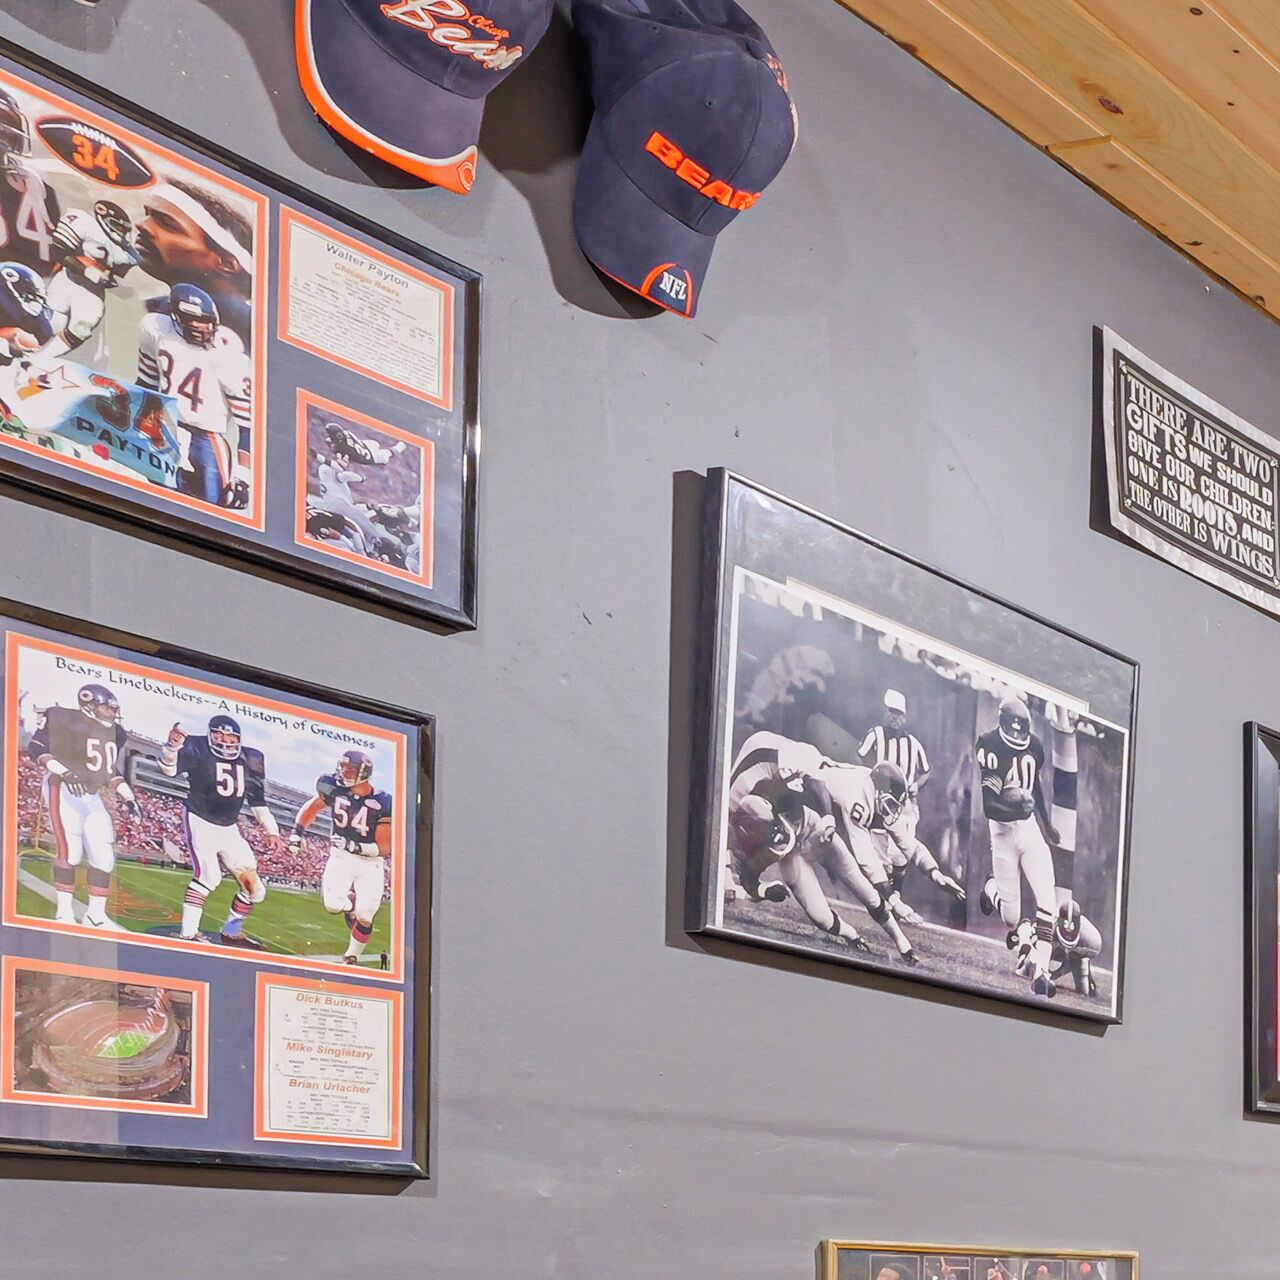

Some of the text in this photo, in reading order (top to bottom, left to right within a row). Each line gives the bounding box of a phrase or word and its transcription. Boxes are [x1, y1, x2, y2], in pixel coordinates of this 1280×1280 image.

[72, 134, 119, 181] 34
[325, 243, 409, 289] Walter Payton
[334, 262, 372, 284] Chicago
[659, 271, 688, 301] NFL
[75, 416, 177, 478] PAYTON
[1127, 375, 1271, 484] THERE ARE TWO
[1126, 403, 1273, 507] GIFTS WE SHOULD
[1128, 430, 1276, 530] GIVE OUR CHILDREN:
[1128, 455, 1160, 491] ONE
[1162, 475, 1178, 502] IS
[1242, 522, 1275, 553] AND
[1128, 480, 1152, 512] THE
[1153, 495, 1191, 535] OTHER
[1193, 519, 1208, 543] IS
[55, 657, 103, 679] Bears
[235, 704, 289, 730] History
[293, 720, 307, 731] of
[310, 724, 376, 750] Greatness
[85, 738, 118, 774] 50
[977, 748, 998, 769] 40
[215, 762, 245, 797] 51
[334, 796, 370, 837] 54
[296, 992, 363, 1010] Dick Butkus
[286, 1042, 373, 1060] Mike Singletary
[289, 1078, 370, 1094] Brian Urlacher
